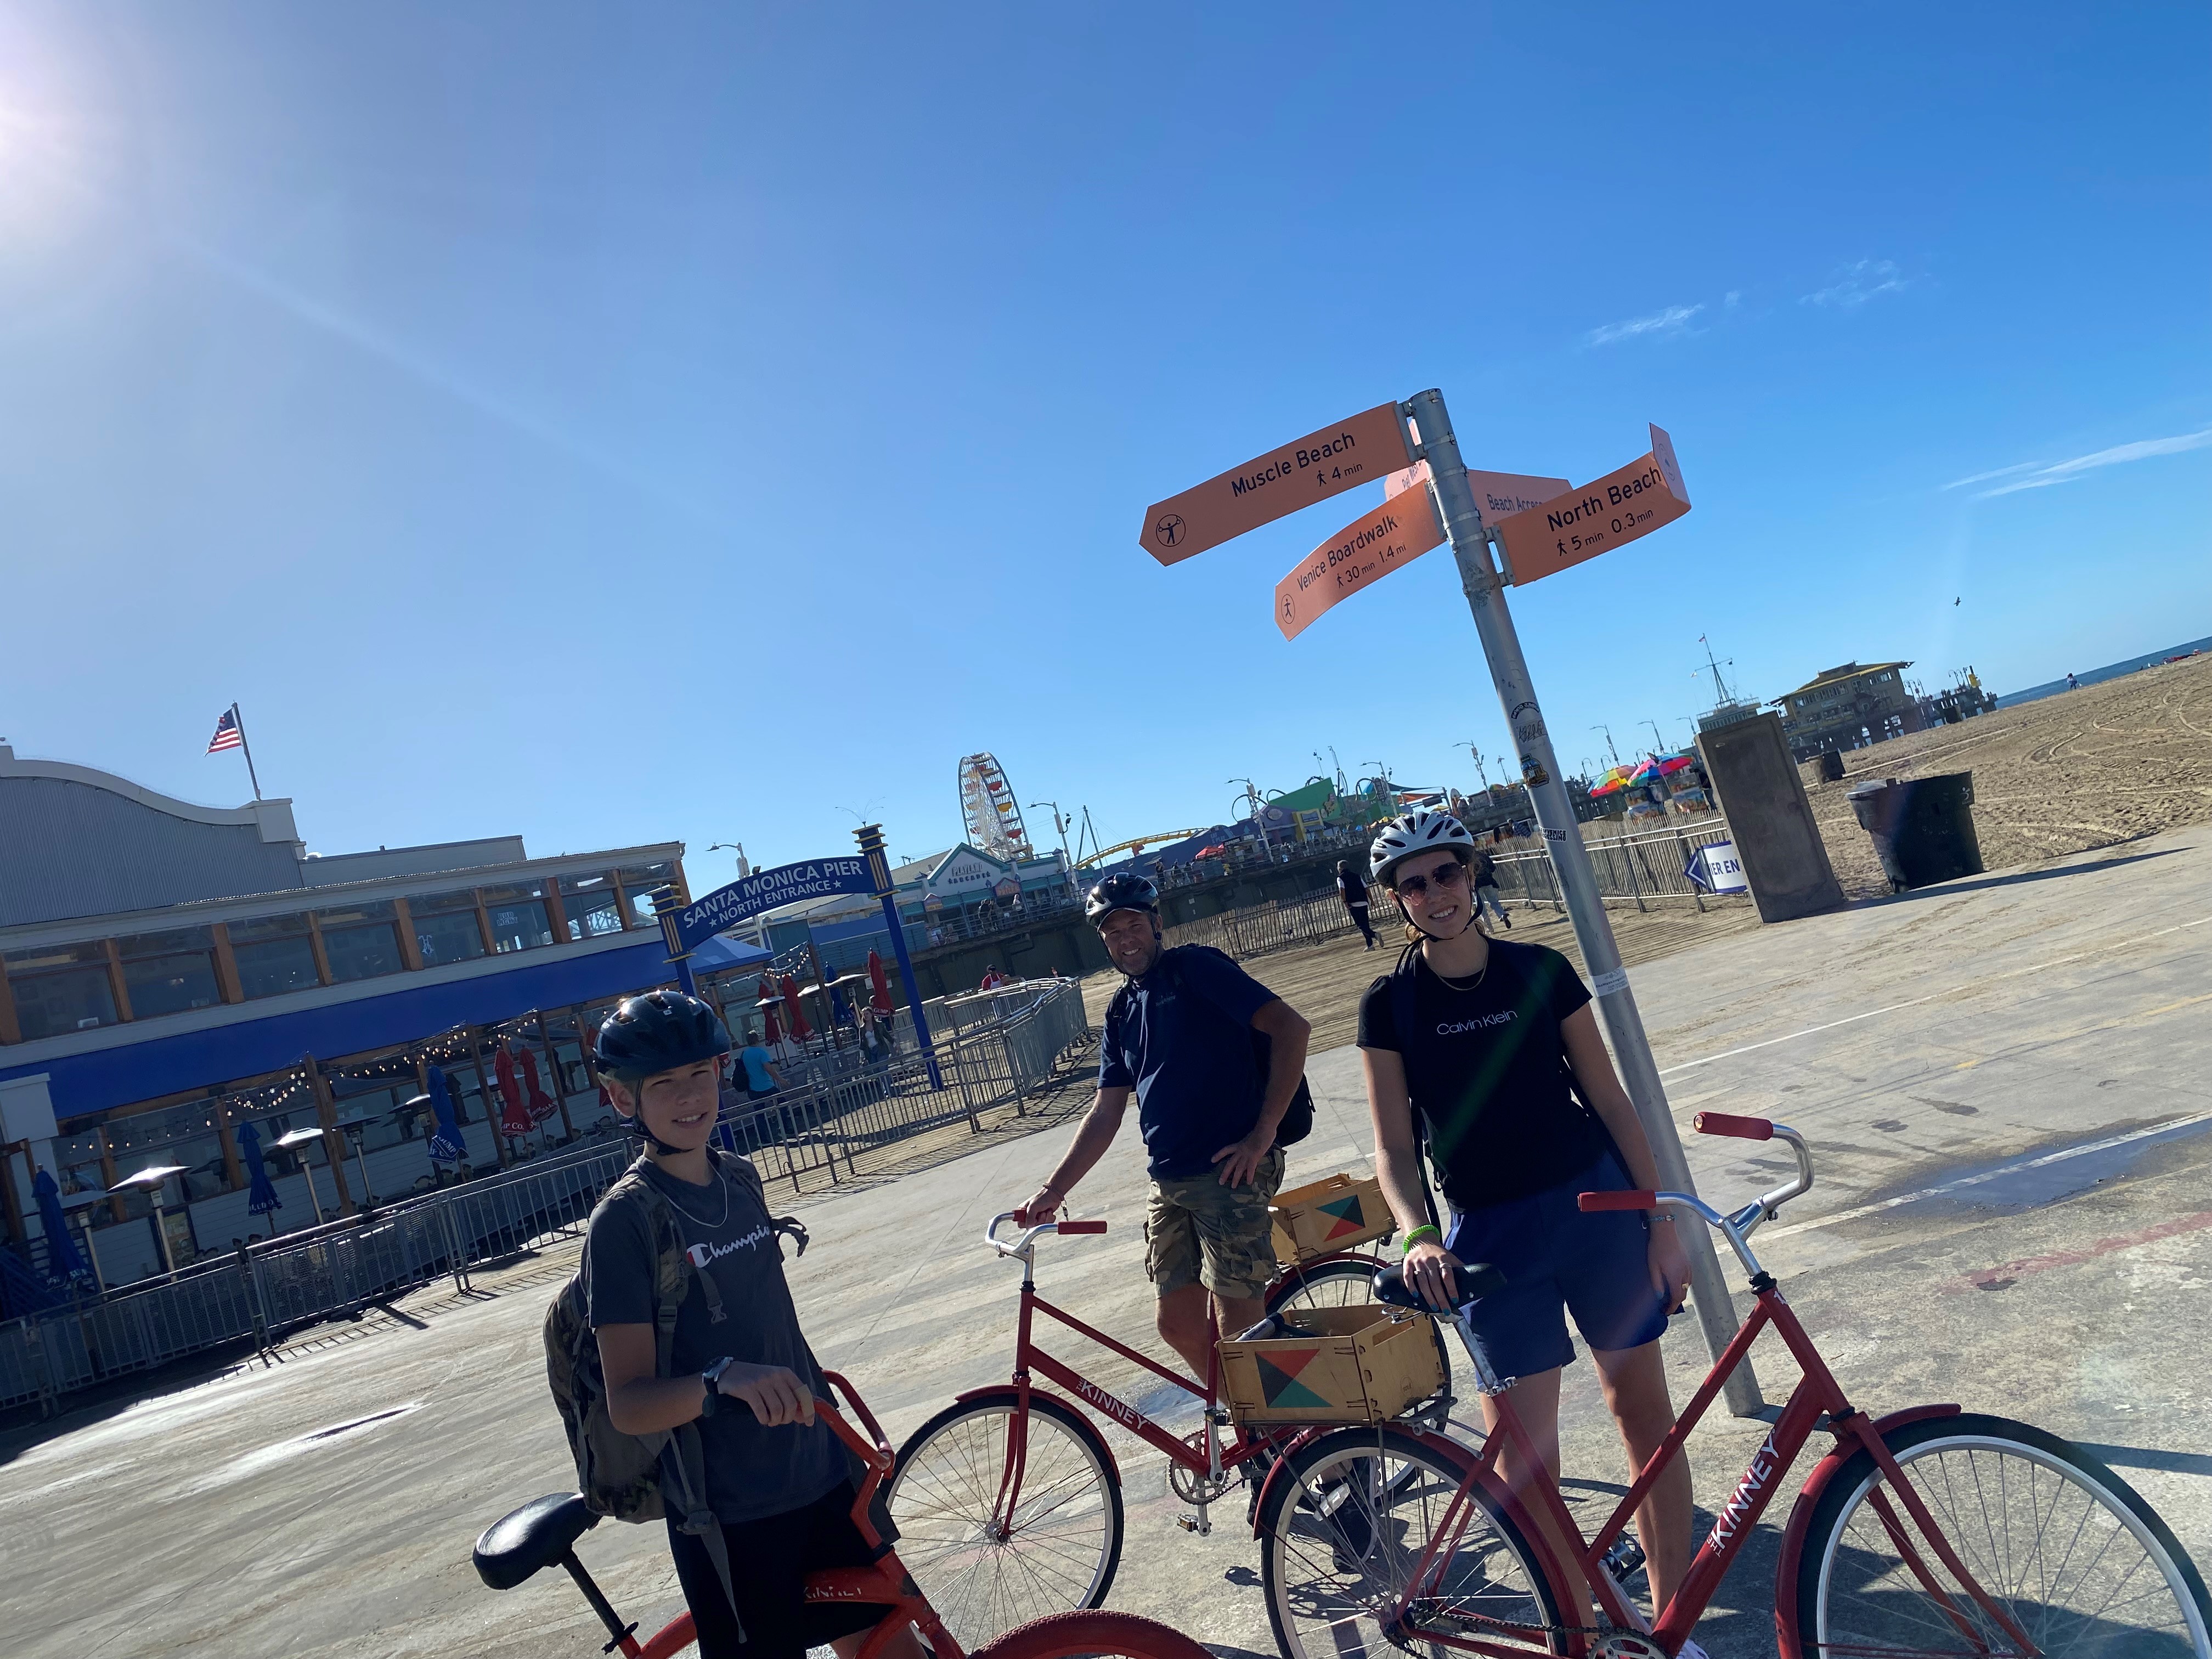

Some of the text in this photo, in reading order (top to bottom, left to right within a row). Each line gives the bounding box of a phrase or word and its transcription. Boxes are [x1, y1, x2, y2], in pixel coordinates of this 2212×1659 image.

[1231, 432, 1356, 498] Muscle Beach
[1331, 463, 1363, 480] 4 min
[1486, 493, 1515, 512] Beach
[1547, 466, 1662, 532] North Beach
[1571, 508, 1654, 551] 5 min 0.3 min
[1297, 514, 1398, 592] Venice Boardwalk
[1345, 542, 1407, 583] 30 min 1.4 mi
[952, 863, 983, 877] PLAYLAND
[953, 872, 986, 884] ARCADE
[683, 860, 864, 929] SANTA MONICA PIER
[718, 879, 832, 923] NORTH ENTRANCE
[1437, 1010, 1518, 1035] Calvin Klein
[1075, 1377, 1085, 1391] THE
[1080, 1380, 1148, 1430] KINNEY
[1711, 1432, 1779, 1549] KINNEY
[1706, 1537, 1723, 1558] THE
